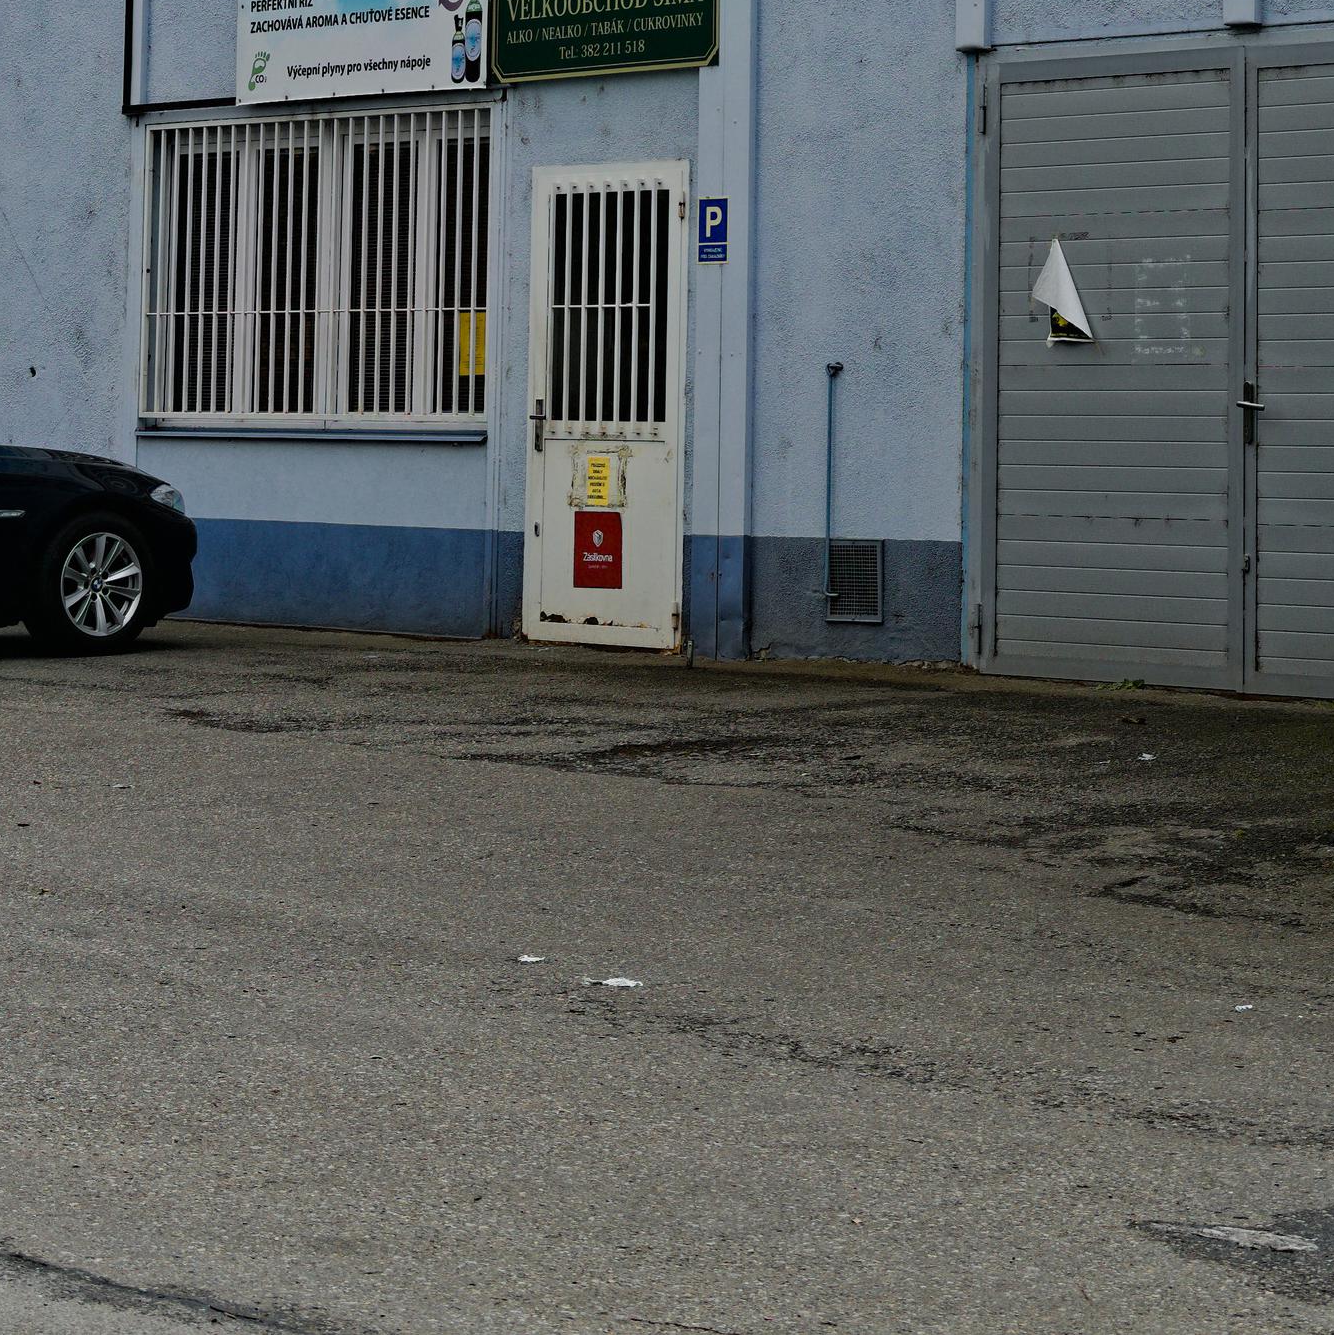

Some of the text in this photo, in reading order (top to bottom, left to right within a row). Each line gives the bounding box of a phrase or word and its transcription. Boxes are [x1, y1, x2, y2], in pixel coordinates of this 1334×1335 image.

[250, 14, 303, 34] ZACHOVÁVÁ
[305, 13, 339, 28] AROMA
[341, 13, 348, 25] A
[394, 5, 430, 21] ESENCE
[507, 28, 533, 45] ALKO
[541, 24, 582, 41] NEALKO
[591, 17, 624, 36] TABÁK
[633, 11, 704, 32] CUKROVINKY
[581, 42, 601, 58] 382
[603, 41, 621, 56] 211
[625, 39, 645, 54] 518
[287, 54, 431, 80] Výčepní plyny pro všechny nápoje
[706, 206, 722, 237] P
